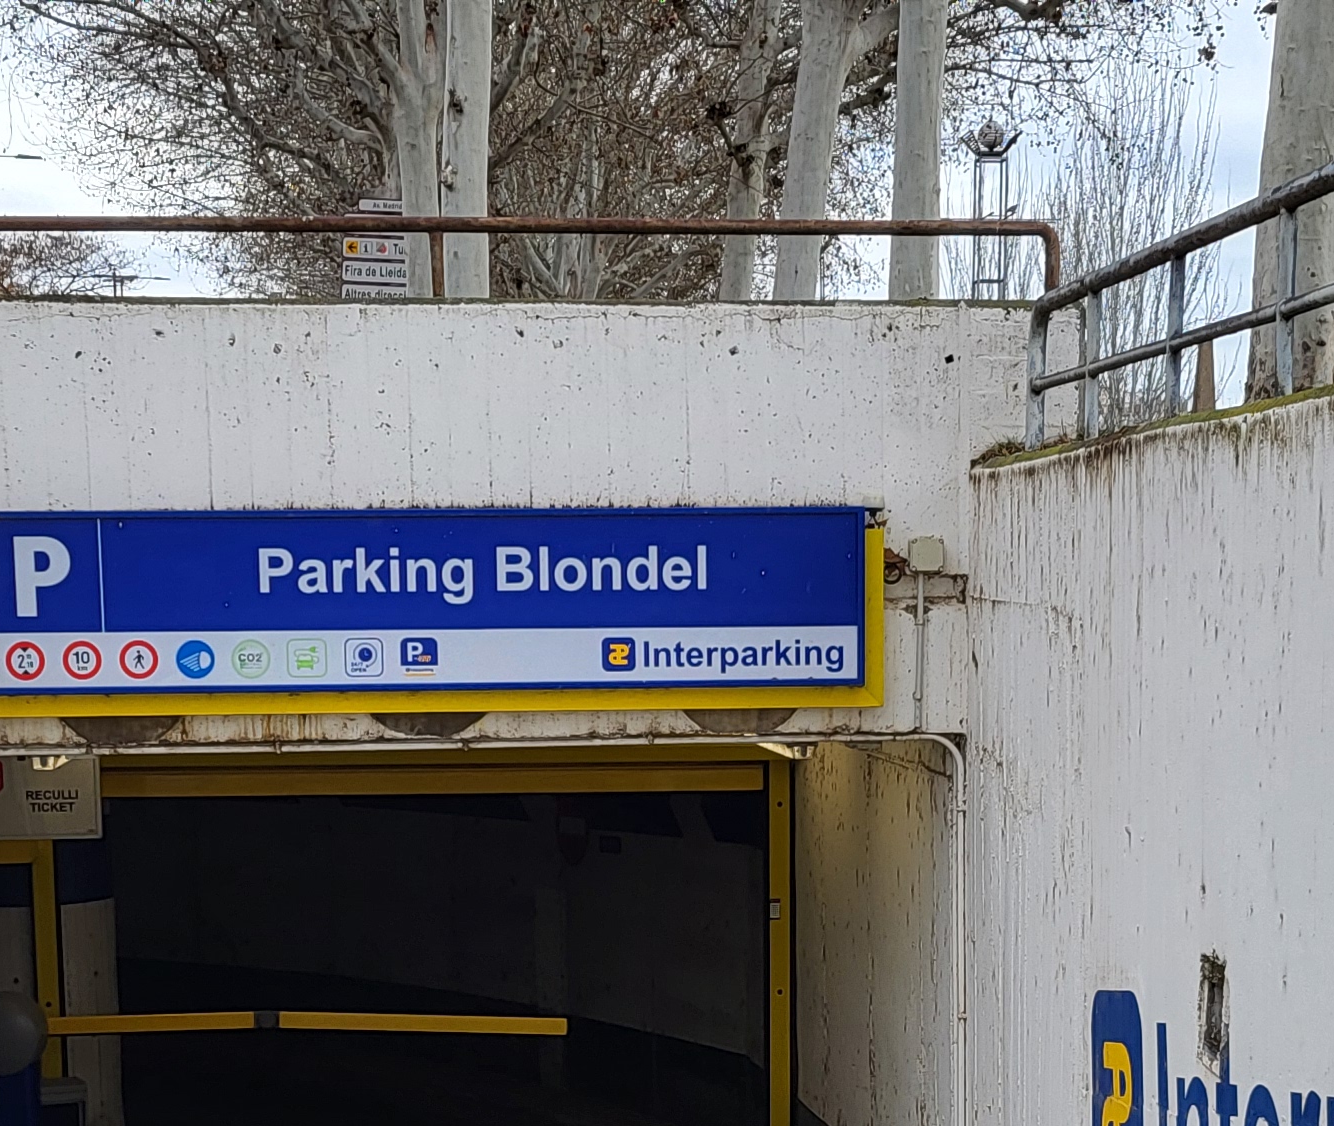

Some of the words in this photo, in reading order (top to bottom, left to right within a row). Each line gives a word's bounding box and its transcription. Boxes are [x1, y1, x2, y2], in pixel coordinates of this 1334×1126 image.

[345, 265, 362, 276] Fira
[366, 266, 376, 276] de
[380, 267, 407, 278] Lleida
[375, 289, 406, 299] direcci
[14, 537, 70, 616] P
[259, 548, 473, 604] Parking
[497, 546, 706, 591] Blondel
[73, 651, 90, 665] 10
[238, 653, 262, 662] CO2
[643, 639, 844, 673] Interparking
[26, 790, 79, 800] RECULLI
[30, 802, 75, 812] TICKET
